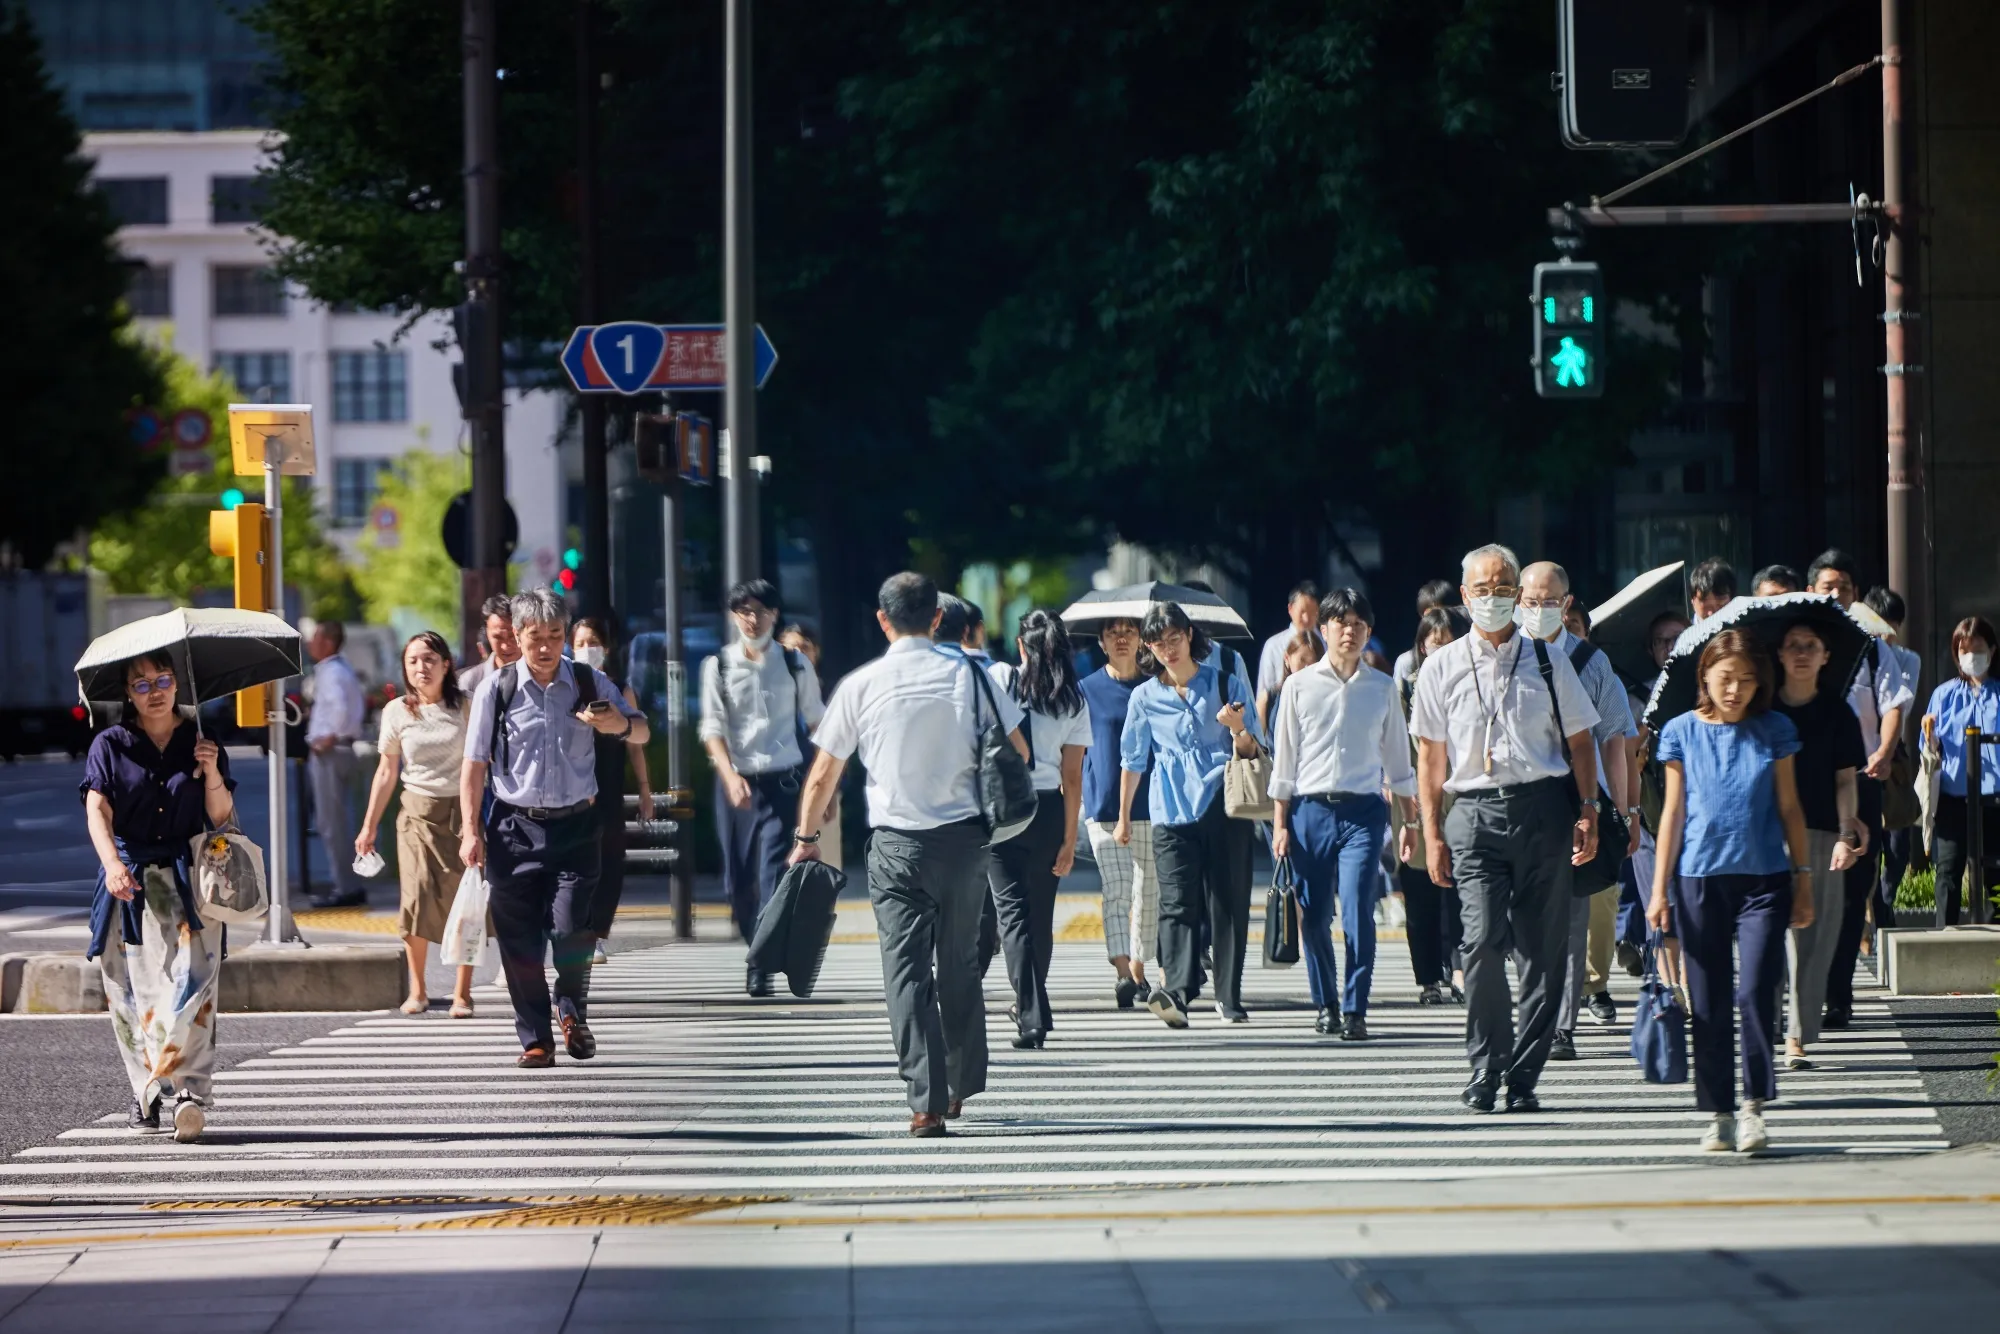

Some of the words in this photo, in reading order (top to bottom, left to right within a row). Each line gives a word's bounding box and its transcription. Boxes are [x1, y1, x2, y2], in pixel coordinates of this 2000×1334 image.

[616, 334, 634, 374] 1
[669, 335, 727, 363] 永代通
